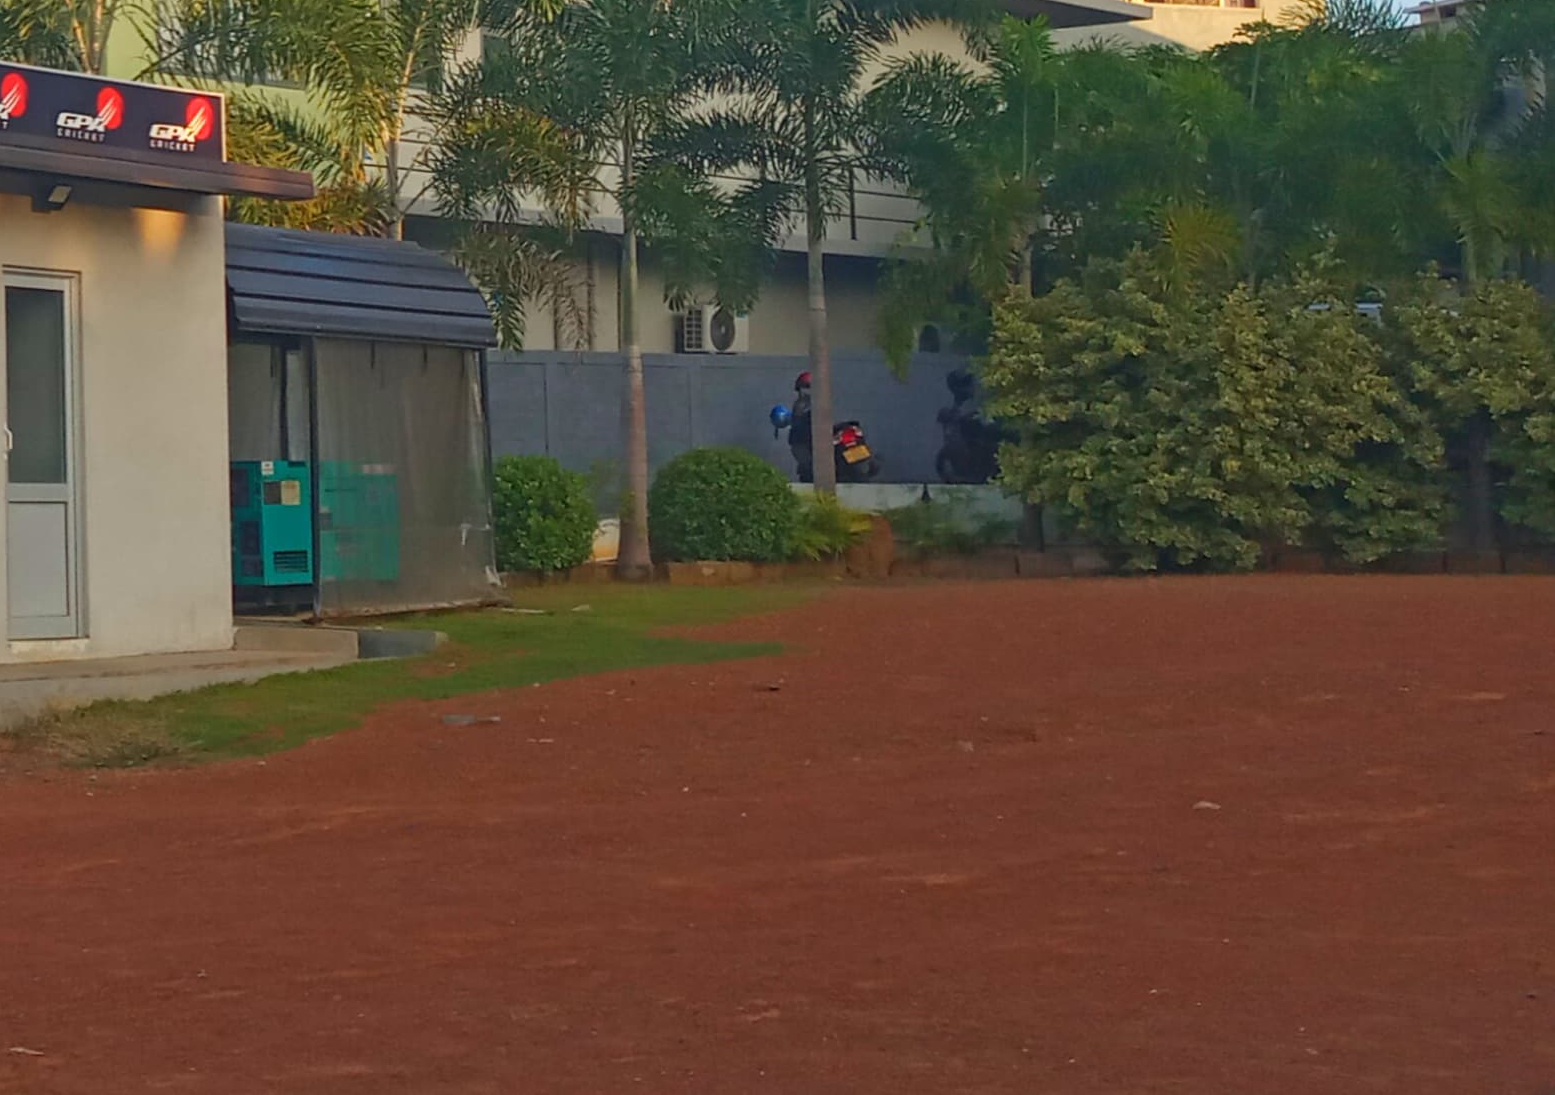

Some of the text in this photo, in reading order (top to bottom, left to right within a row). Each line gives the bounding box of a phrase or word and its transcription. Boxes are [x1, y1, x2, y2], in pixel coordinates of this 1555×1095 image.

[56, 112, 107, 132] GPA
[57, 127, 106, 143] CRICKET
[149, 124, 195, 143] GPA
[150, 139, 195, 152] CRICKET
